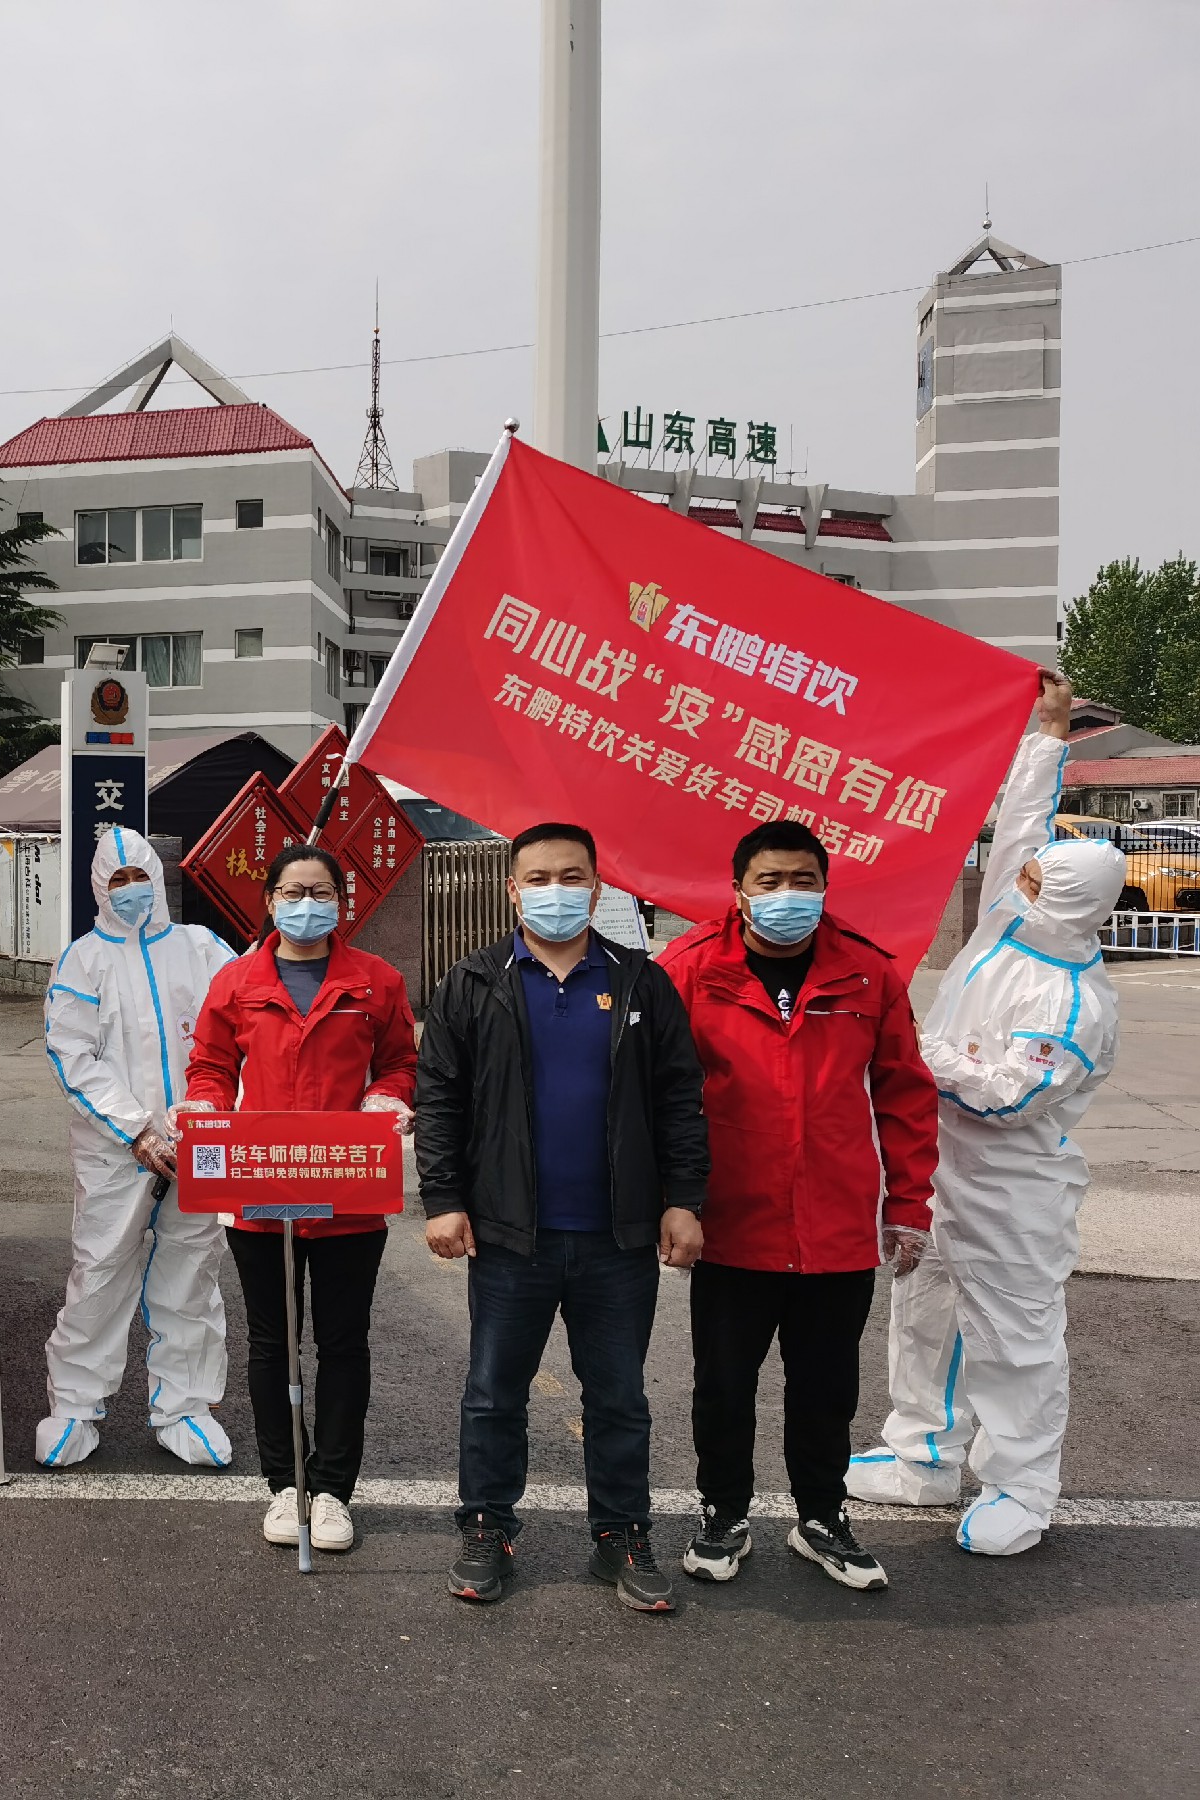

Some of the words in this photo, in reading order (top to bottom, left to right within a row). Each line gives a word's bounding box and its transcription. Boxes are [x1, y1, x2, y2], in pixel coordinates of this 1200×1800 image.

[623, 405, 777, 465] 山东高速
[664, 602, 859, 716] 东鹏特饮
[321, 763, 331, 788] 文明
[493, 672, 886, 866] 东鹏特饮关爱货车司机活动
[339, 796, 350, 821] 民主
[254, 806, 267, 861] 社会主义
[373, 817, 383, 839] 公正
[387, 815, 397, 839] 自由
[372, 844, 383, 869] 法治
[386, 844, 397, 869] 平等
[346, 870, 356, 894] 爱国
[229, 1144, 387, 1164] 货车师傅您辛苦了
[229, 1167, 388, 1179] 扫二维码免费领取东鹏特饮1箱
